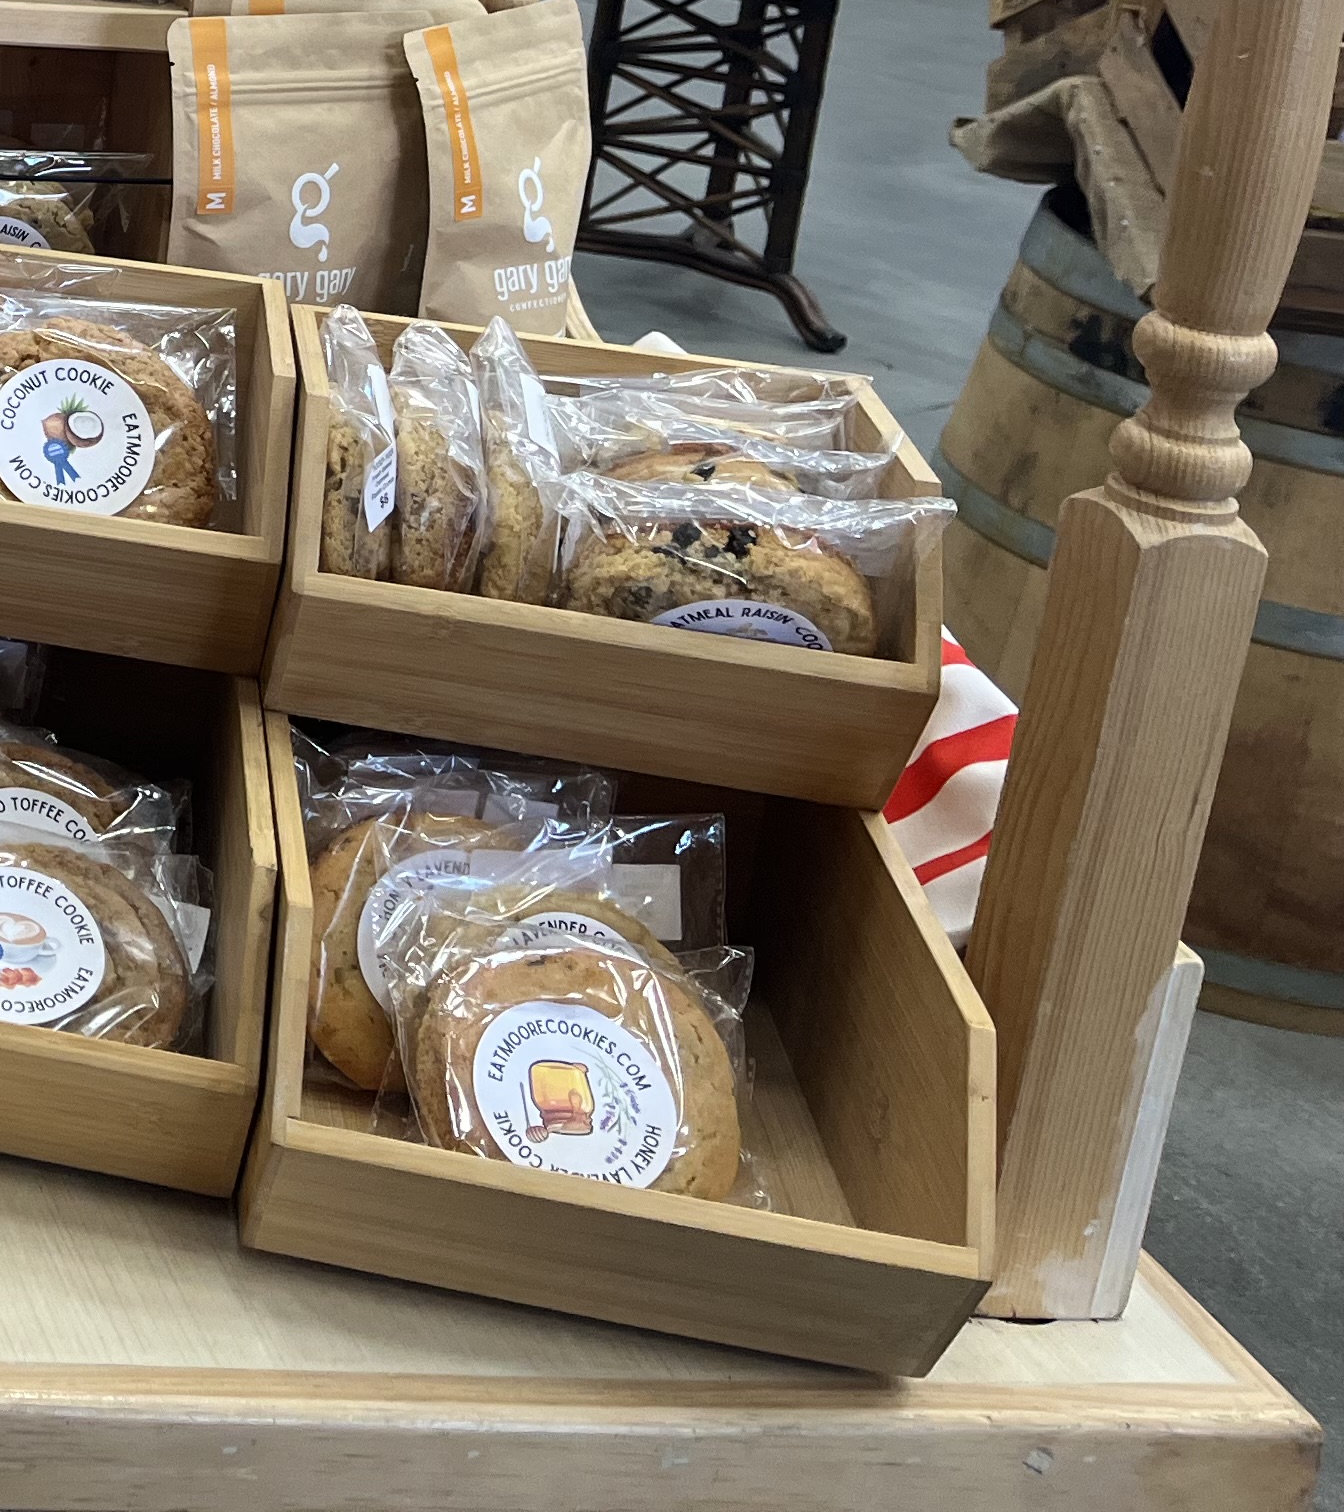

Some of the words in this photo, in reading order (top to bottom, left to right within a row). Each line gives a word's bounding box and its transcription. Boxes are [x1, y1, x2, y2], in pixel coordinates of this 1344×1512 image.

[207, 63, 218, 100] ALMOND
[211, 104, 223, 156] CHOCOLATE
[454, 108, 469, 159] CHOCOLATE
[212, 157, 223, 181] MILK
[463, 159, 472, 184] MILK
[494, 263, 539, 302] gary
[0, 370, 50, 431] COCONUT
[54, 366, 115, 397] COOKIE
[8, 412, 140, 506] EATMOORECOOKIES.COM
[740, 606, 792, 626] RAISIN
[10, 797, 64, 824] TOFFEE
[54, 895, 94, 946] COOKIE
[488, 1018, 651, 1091] EATMOORECOOKIES.COM
[494, 1110, 543, 1169] COOKIE
[631, 1124, 662, 1173] HONEY
